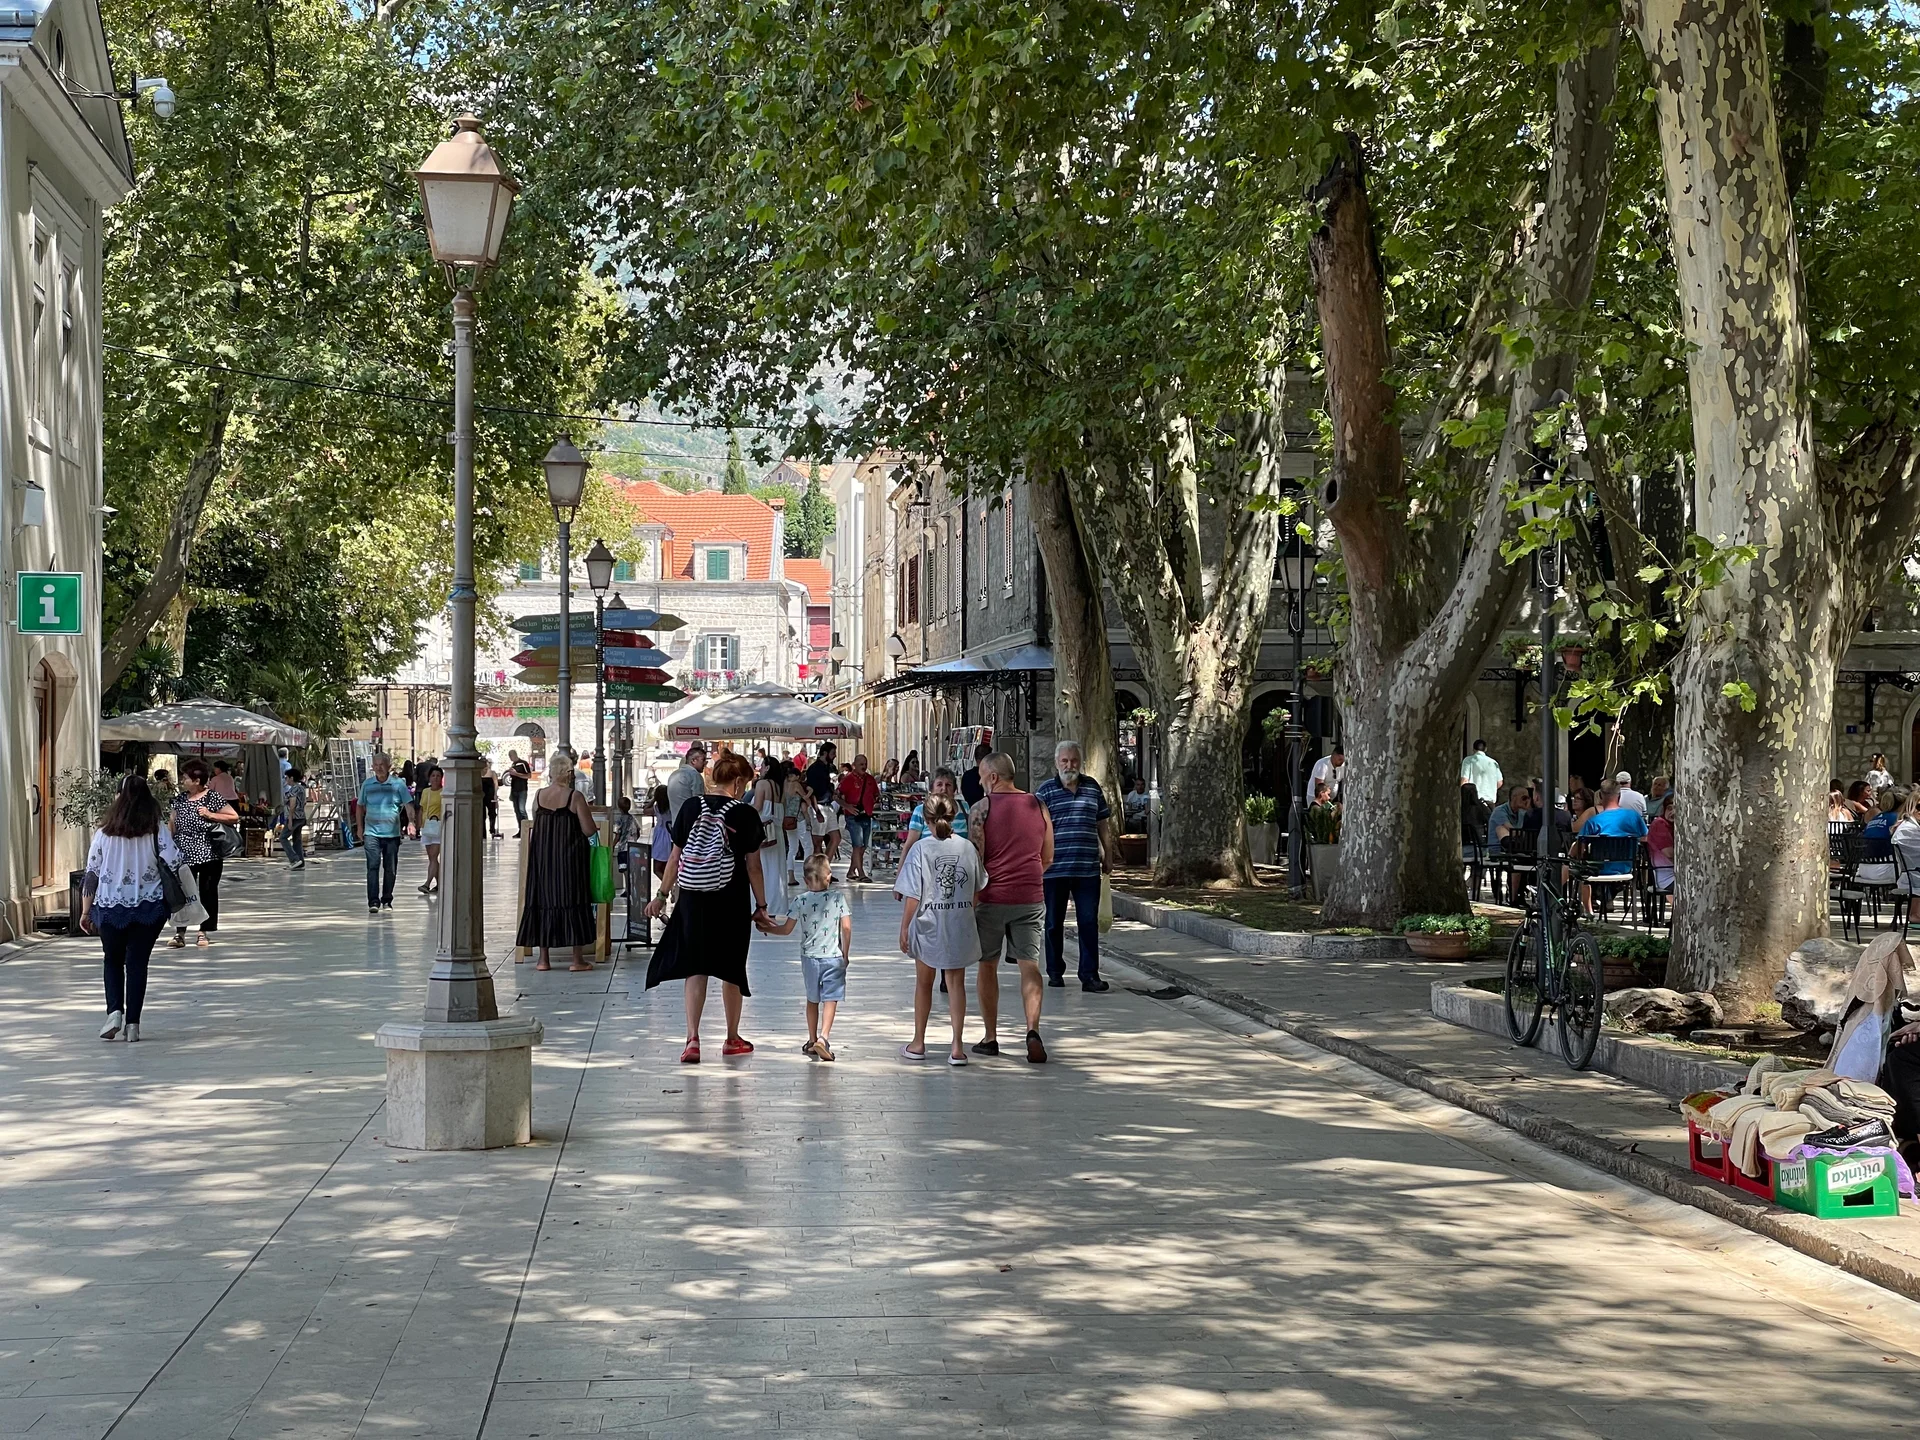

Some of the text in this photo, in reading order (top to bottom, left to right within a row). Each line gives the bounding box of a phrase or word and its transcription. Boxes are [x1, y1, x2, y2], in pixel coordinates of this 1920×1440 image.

[610, 684, 635, 692] Софија
[477, 708, 513, 718] RVENA
[194, 729, 247, 741] ТРЕБИЊЕ
[722, 727, 751, 735] NAJBOLJE
[925, 902, 955, 910] PATRIOT
